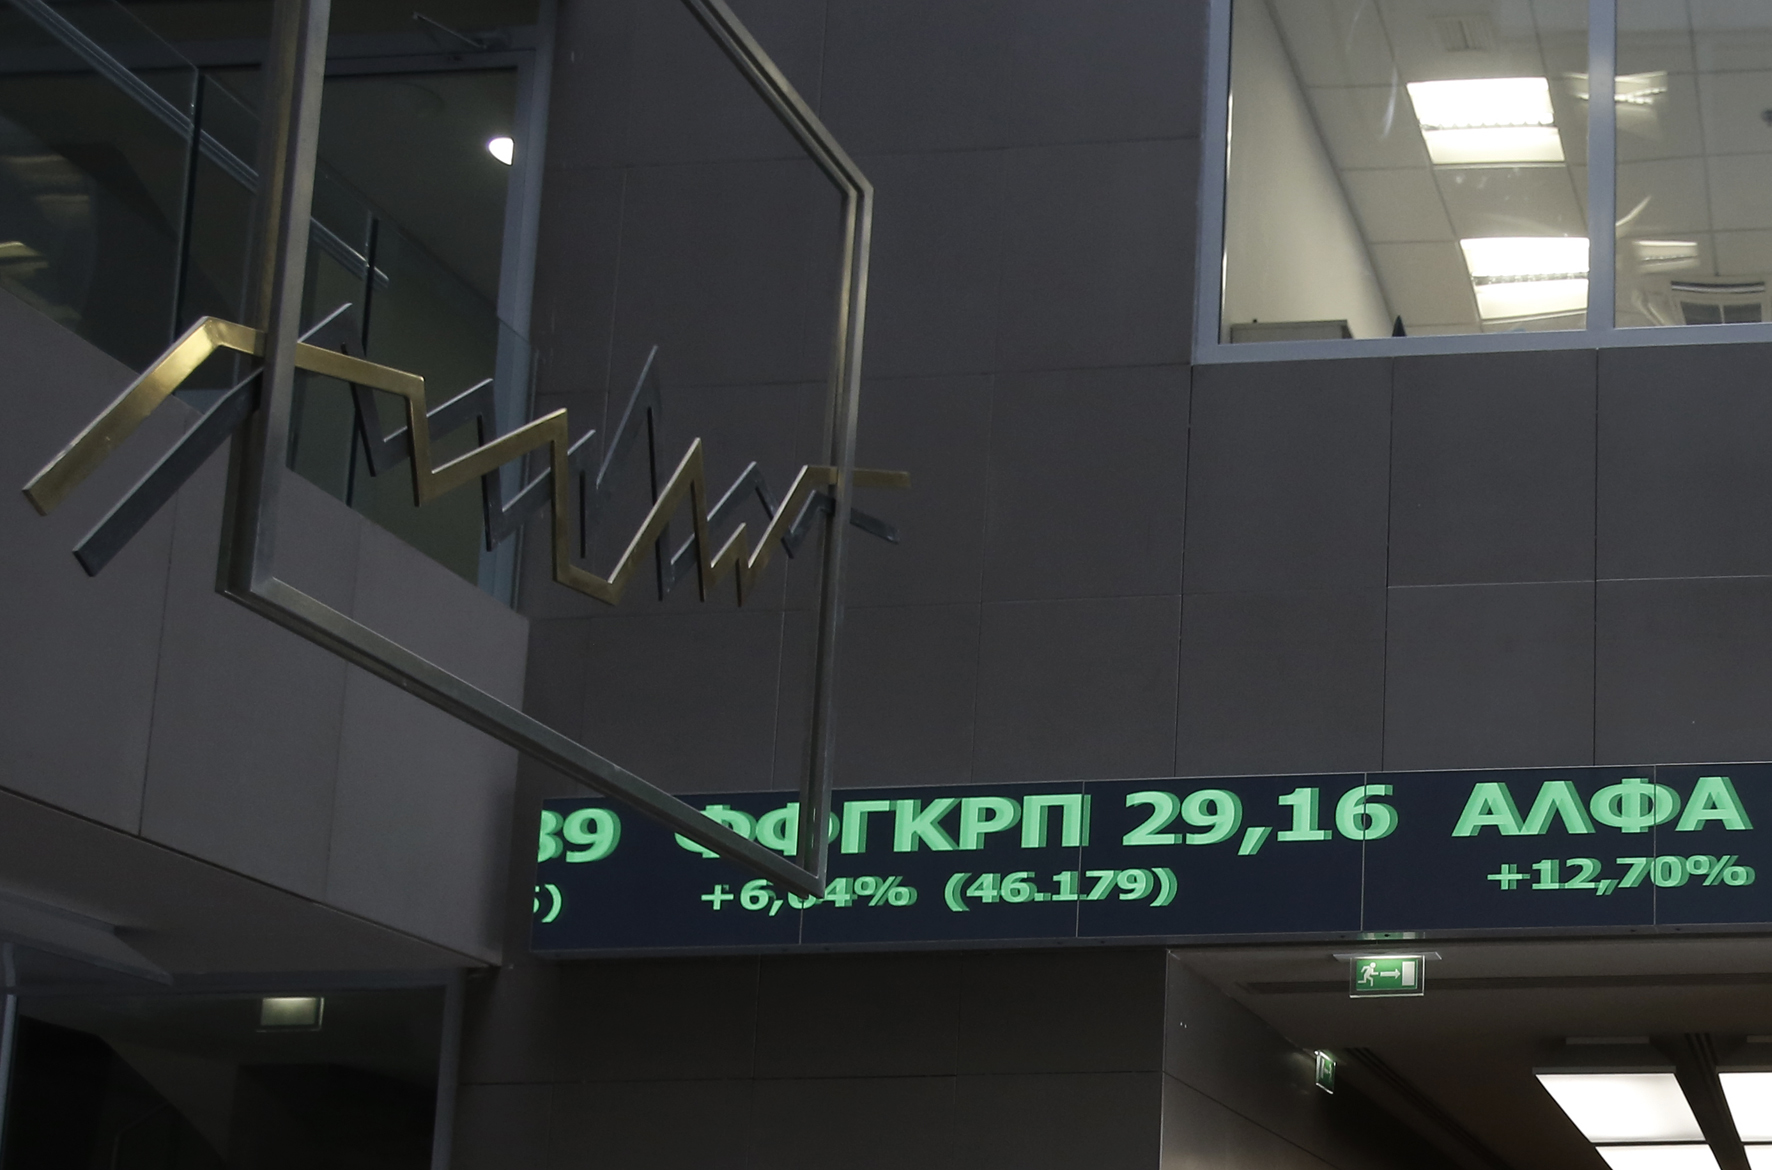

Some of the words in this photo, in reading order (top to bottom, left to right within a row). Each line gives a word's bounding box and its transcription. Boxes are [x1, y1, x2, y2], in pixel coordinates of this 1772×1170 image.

[1123, 784, 1398, 855] 29,16
[1452, 777, 1752, 837] ΑΛΦΑ
[944, 868, 1178, 912] (46.179)
[1487, 855, 1755, 896] +12,70%
